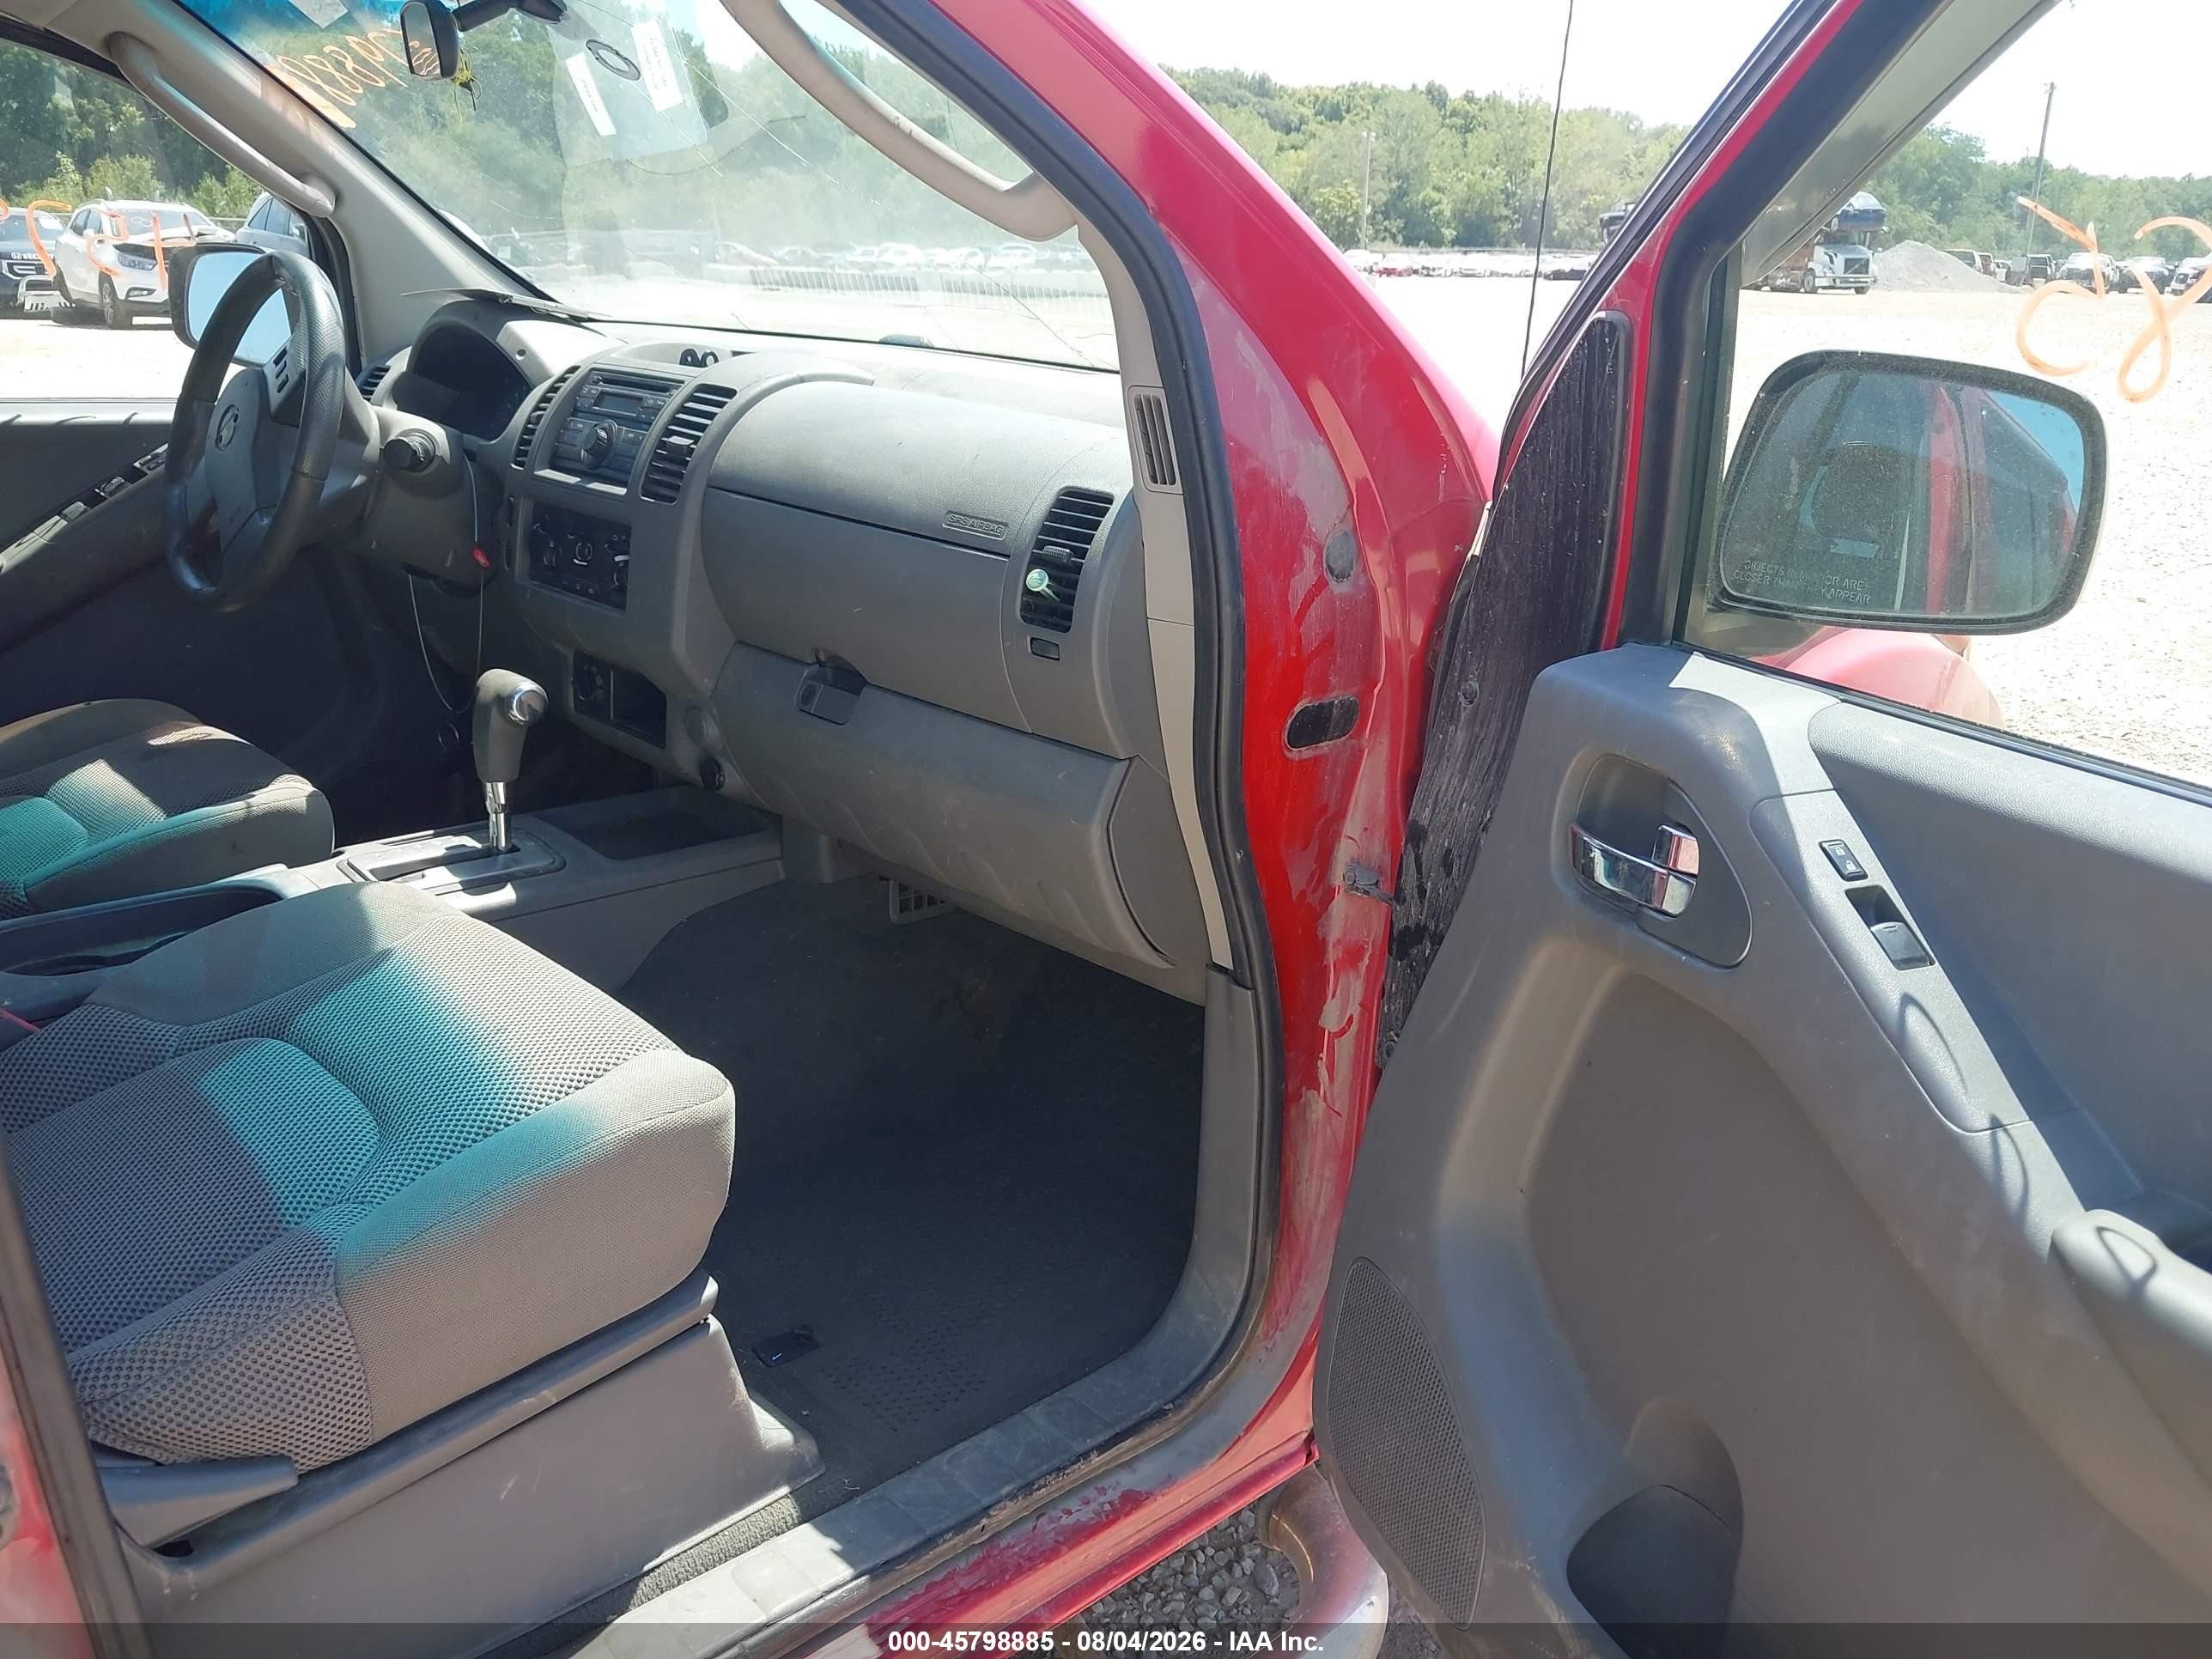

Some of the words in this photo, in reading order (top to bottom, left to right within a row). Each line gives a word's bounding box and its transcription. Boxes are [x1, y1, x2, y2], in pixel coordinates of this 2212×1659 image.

[948, 514, 969, 526] SRS
[969, 519, 1004, 534] AIRBAG
[1734, 569, 1771, 585] CLOSER
[1826, 588, 1871, 605] APPEAR
[1744, 560, 1784, 576] OBJECTS
[1842, 578, 1864, 591] ARE
